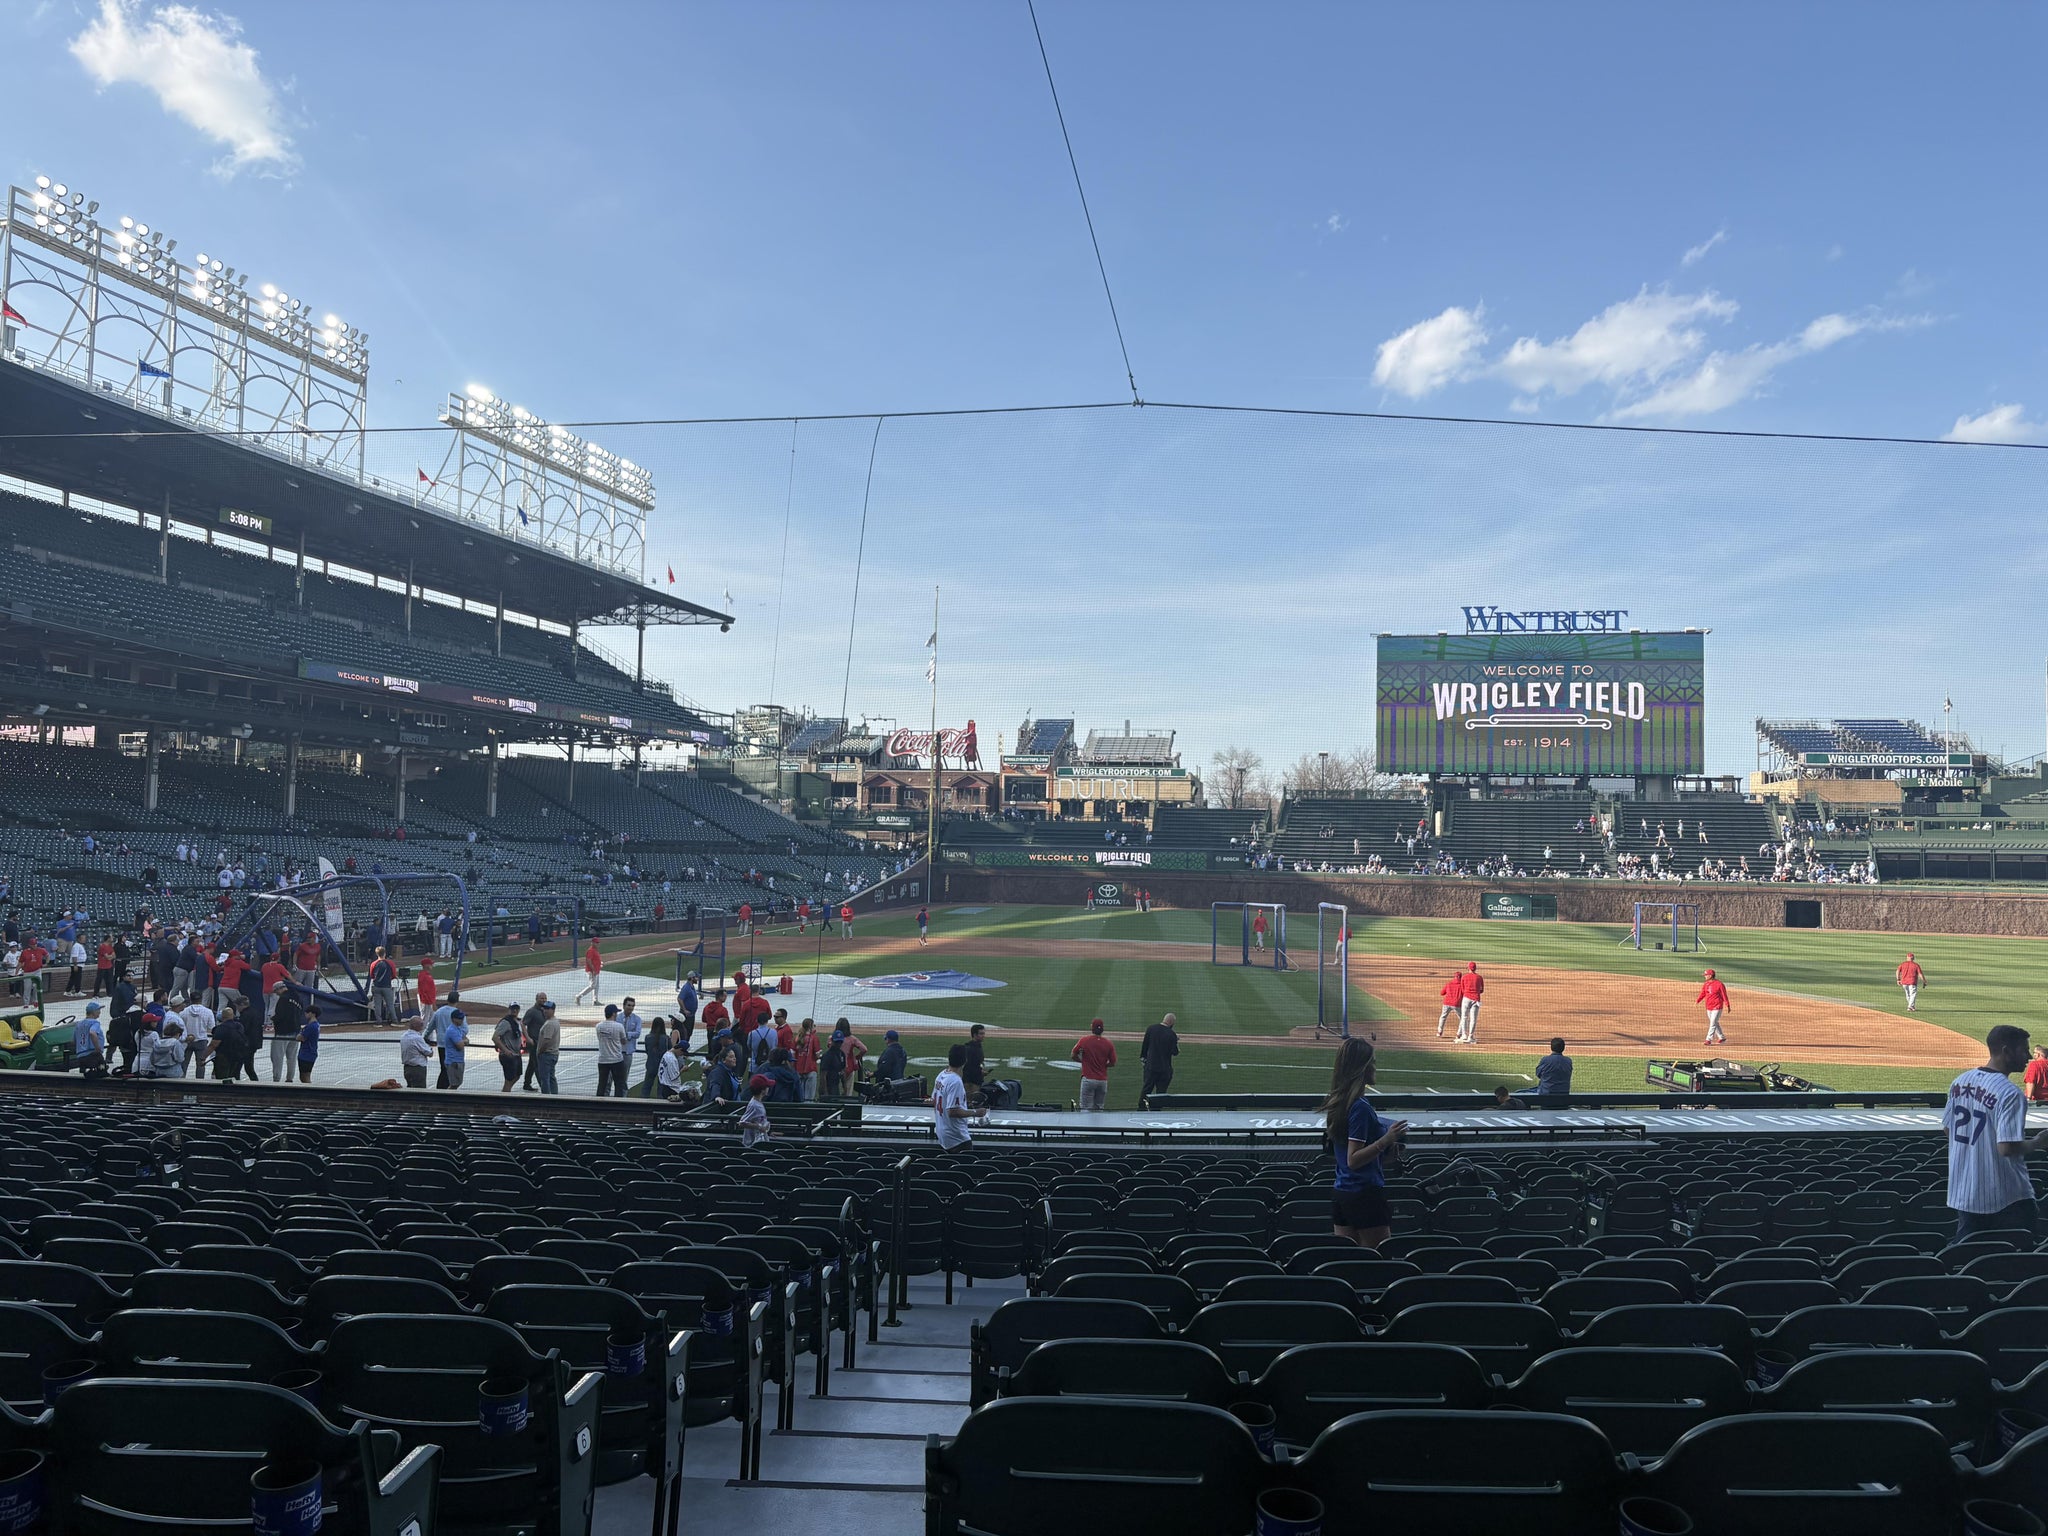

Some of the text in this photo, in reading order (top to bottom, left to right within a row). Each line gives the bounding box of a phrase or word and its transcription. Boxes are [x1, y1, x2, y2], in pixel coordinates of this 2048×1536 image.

[230, 511, 262, 531] 5:08 PM
[1461, 606, 1628, 632] WINTRUST
[1483, 665, 1593, 675] WELCOME TO
[338, 672, 369, 683] WELCOME
[384, 675, 406, 688] WRIGLEY
[406, 679, 419, 692] FIELD
[473, 695, 498, 704] WELCOME
[1433, 682, 1561, 720] WRIGLEY
[1570, 682, 1645, 721] FIELD
[886, 728, 974, 759] Coca-Cola
[1534, 738, 1571, 748] 1914
[1828, 755, 1948, 764] WRIGLEYROOFTOPS.COM
[1072, 767, 1171, 777] WRIGLEYROOFTOPS.COM
[1928, 777, 1963, 787] Mobile
[942, 850, 968, 859] Harvey
[1095, 852, 1129, 863] WRIGLEY
[1130, 853, 1151, 864] FIELD
[1487, 904, 1524, 912] Gallagher
[1465, 1116, 1554, 1127] THE
[1555, 1115, 1756, 1126] FRIENDLY
[1754, 1114, 1944, 1126] CONFINES
[1954, 1105, 1987, 1146] 27
[581, 1433, 587, 1449] 6
[286, 1492, 315, 1511] Hefty
